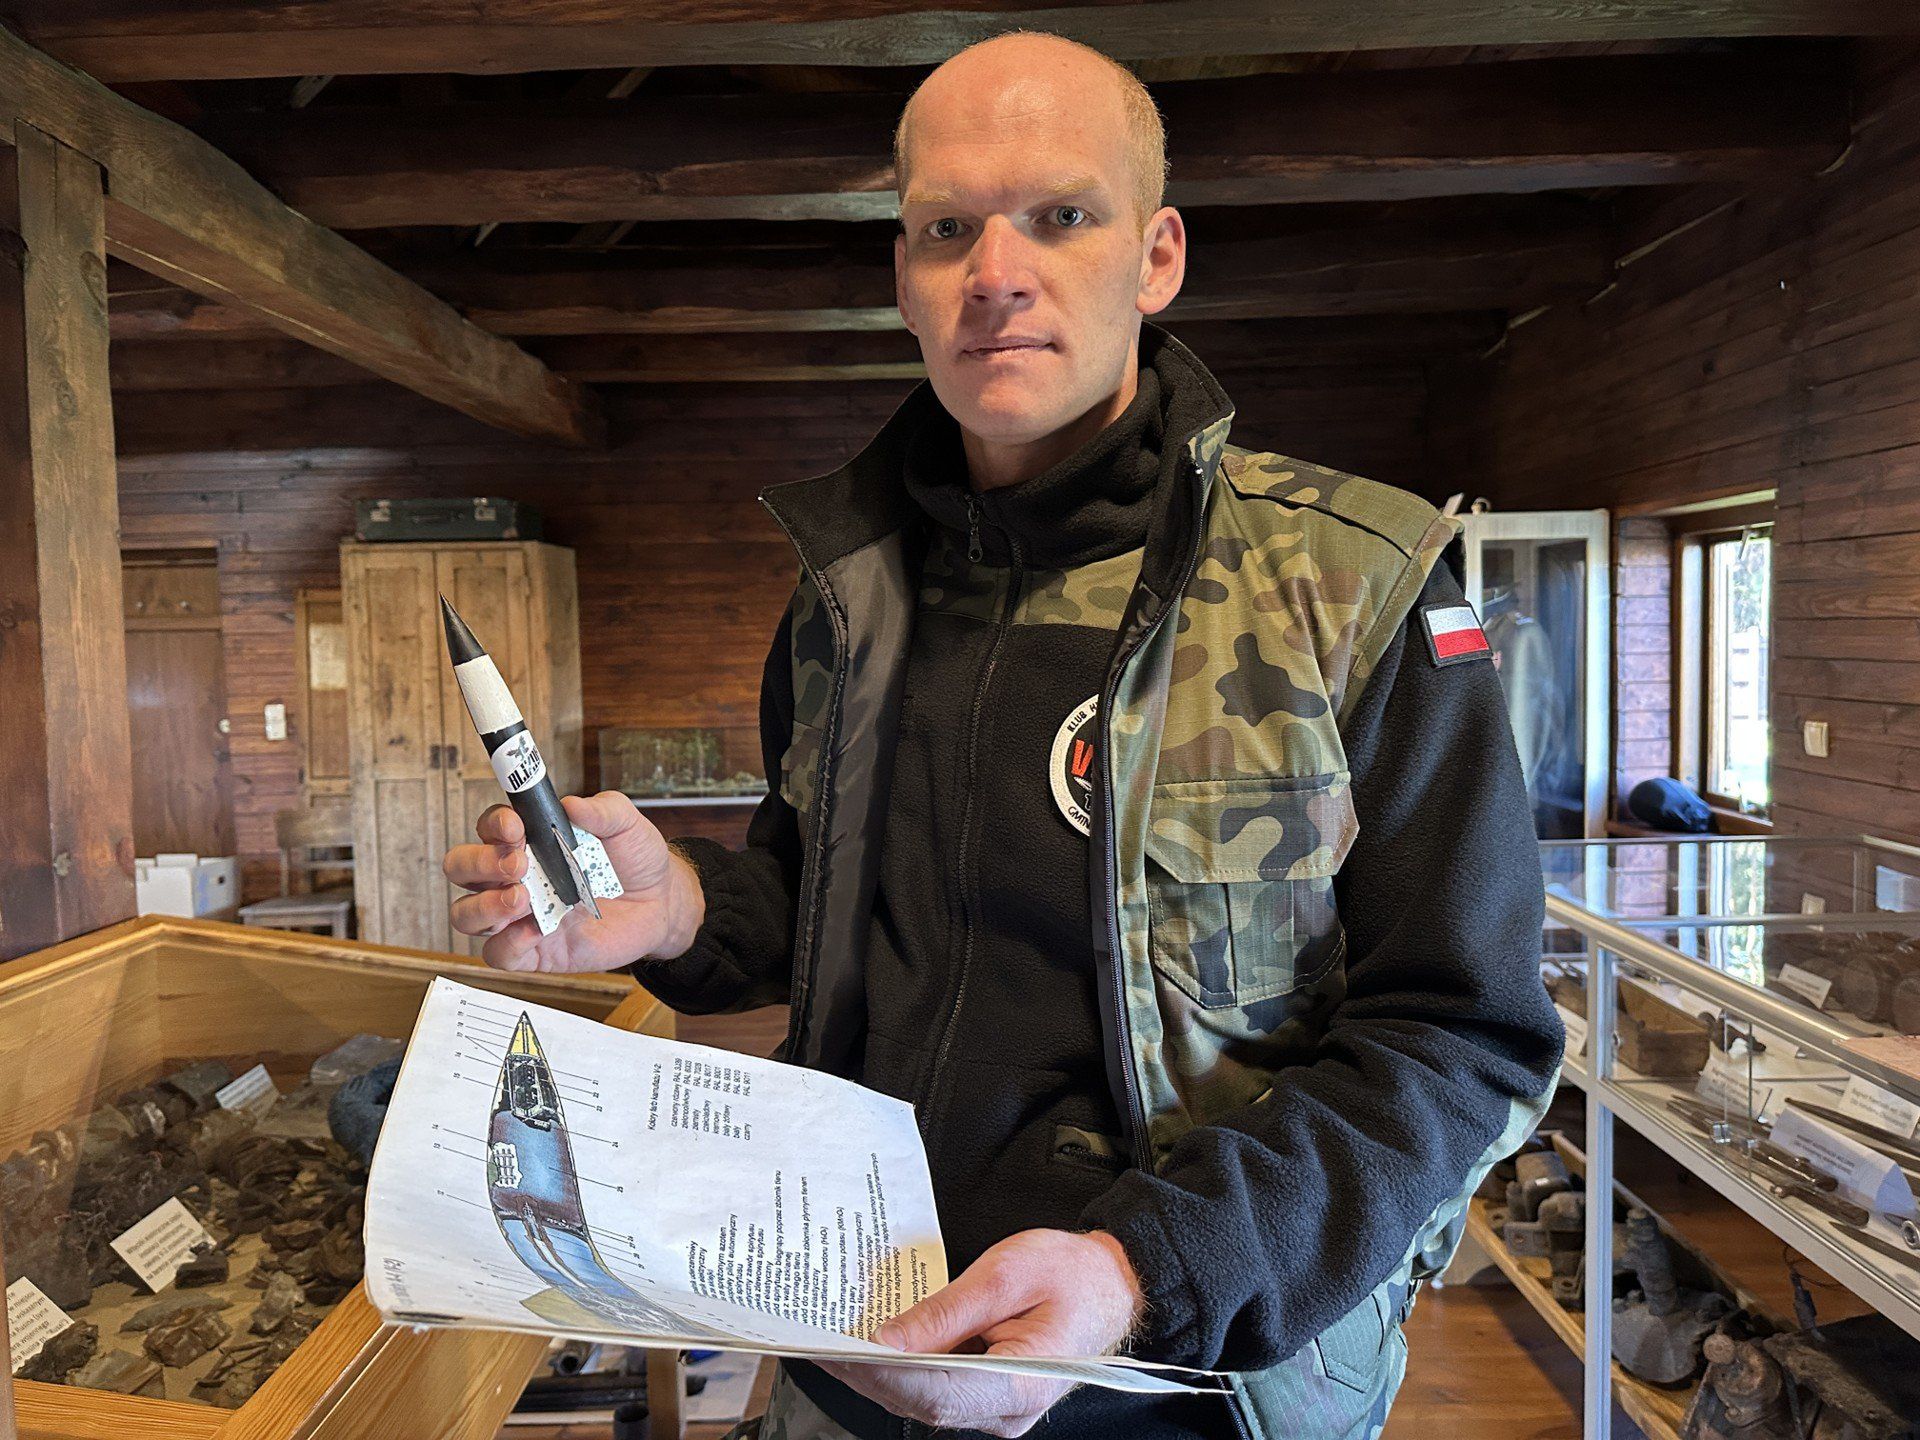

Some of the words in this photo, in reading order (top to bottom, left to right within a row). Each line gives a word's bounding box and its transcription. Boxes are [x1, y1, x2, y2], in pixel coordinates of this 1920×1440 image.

[1067, 711, 1087, 732] KLUB
[649, 1100, 657, 1111] farb
[673, 1083, 681, 1100] rdzawy
[648, 1112, 657, 1130] Kolory
[670, 1101, 679, 1126] czerwony
[702, 1099, 710, 1132] czekoladowy
[712, 1111, 721, 1133] kremowy
[743, 1122, 751, 1140] czarny
[801, 1195, 810, 1221] płynnym
[869, 1195, 877, 1215] komory
[728, 1213, 737, 1258] automatyczny
[747, 1223, 755, 1252] spirytusu
[756, 1227, 764, 1258] spirytusu
[802, 1222, 810, 1250] zbiornika
[839, 1231, 847, 1253] potasu
[880, 1221, 889, 1243] napędu
[774, 1234, 783, 1265] biegnący
[865, 1234, 874, 1276] chłodzącego
[697, 1246, 707, 1282] elektryczny
[717, 1253, 726, 1290] sprężonym
[726, 1260, 734, 1275] pilot
[745, 1254, 753, 1276] zawór
[783, 1251, 792, 1281] szklanej
[802, 1252, 811, 1293] napełniania
[857, 1259, 865, 1281] (zawór
[892, 1246, 902, 1290] napędowego
[735, 1263, 743, 1294] spirytusu
[764, 1260, 772, 1299] elastyczny
[783, 1283, 791, 1300] waty
[792, 1271, 801, 1307] płynnego
[810, 1268, 819, 1307] elastyczny
[820, 1273, 828, 1311] nadtlenku
[838, 1255, 847, 1314] nadmanganianu
[875, 1271, 884, 1297] między
[883, 1245, 892, 1312] elektrohydrauliczny
[801, 1296, 808, 1306] do
[848, 1285, 856, 1303] pary
[866, 1278, 875, 1312] spirytusu
